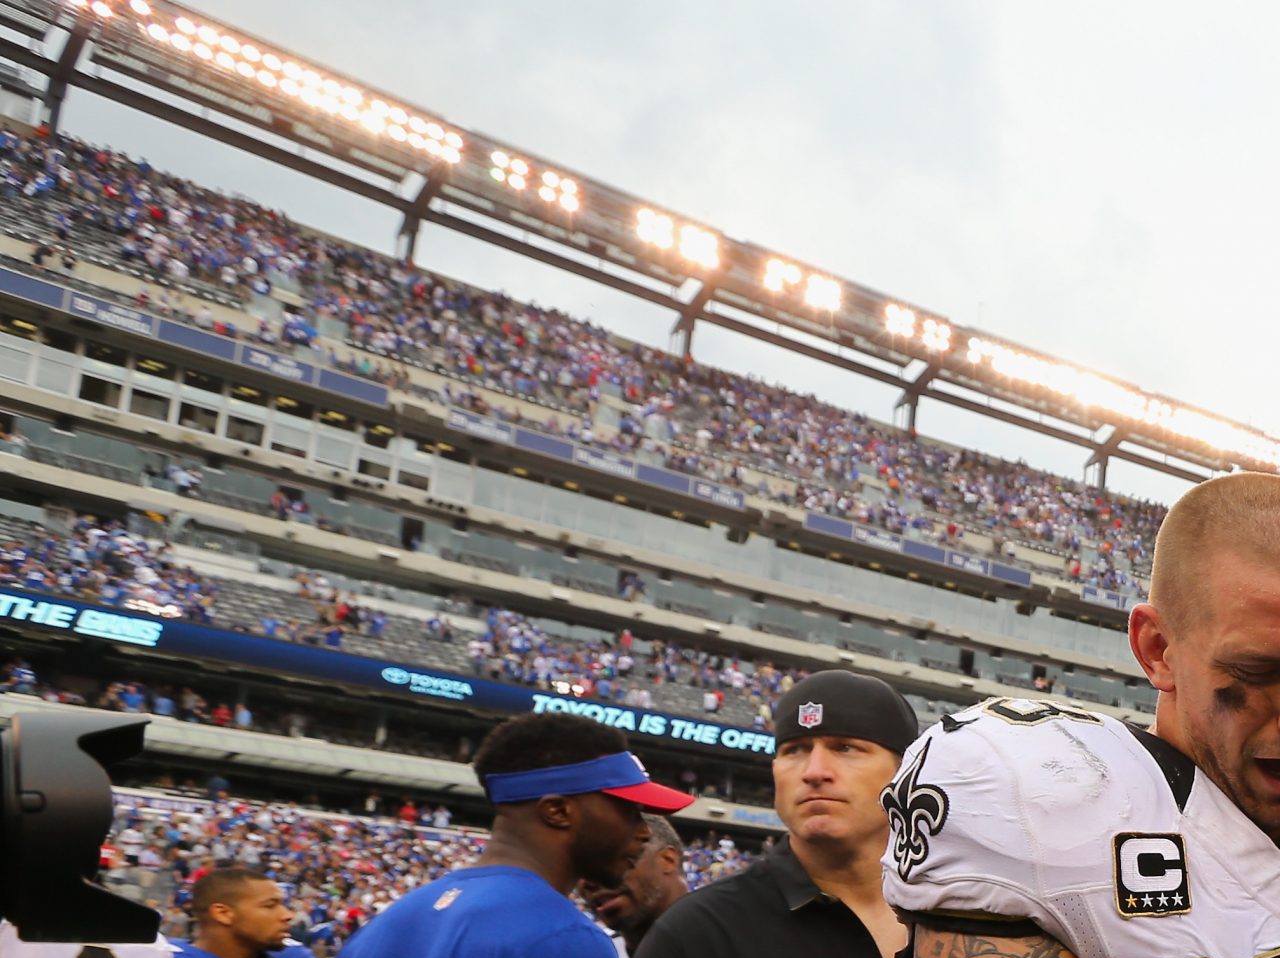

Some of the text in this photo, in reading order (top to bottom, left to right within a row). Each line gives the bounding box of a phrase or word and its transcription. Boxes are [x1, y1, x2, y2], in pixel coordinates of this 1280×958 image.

[0, 593, 77, 628] THE
[409, 672, 473, 696] TOYOTA
[532, 694, 636, 731] TOYOTA
[638, 713, 667, 736] IS
[670, 719, 721, 745] THE
[1119, 837, 1184, 893] C
